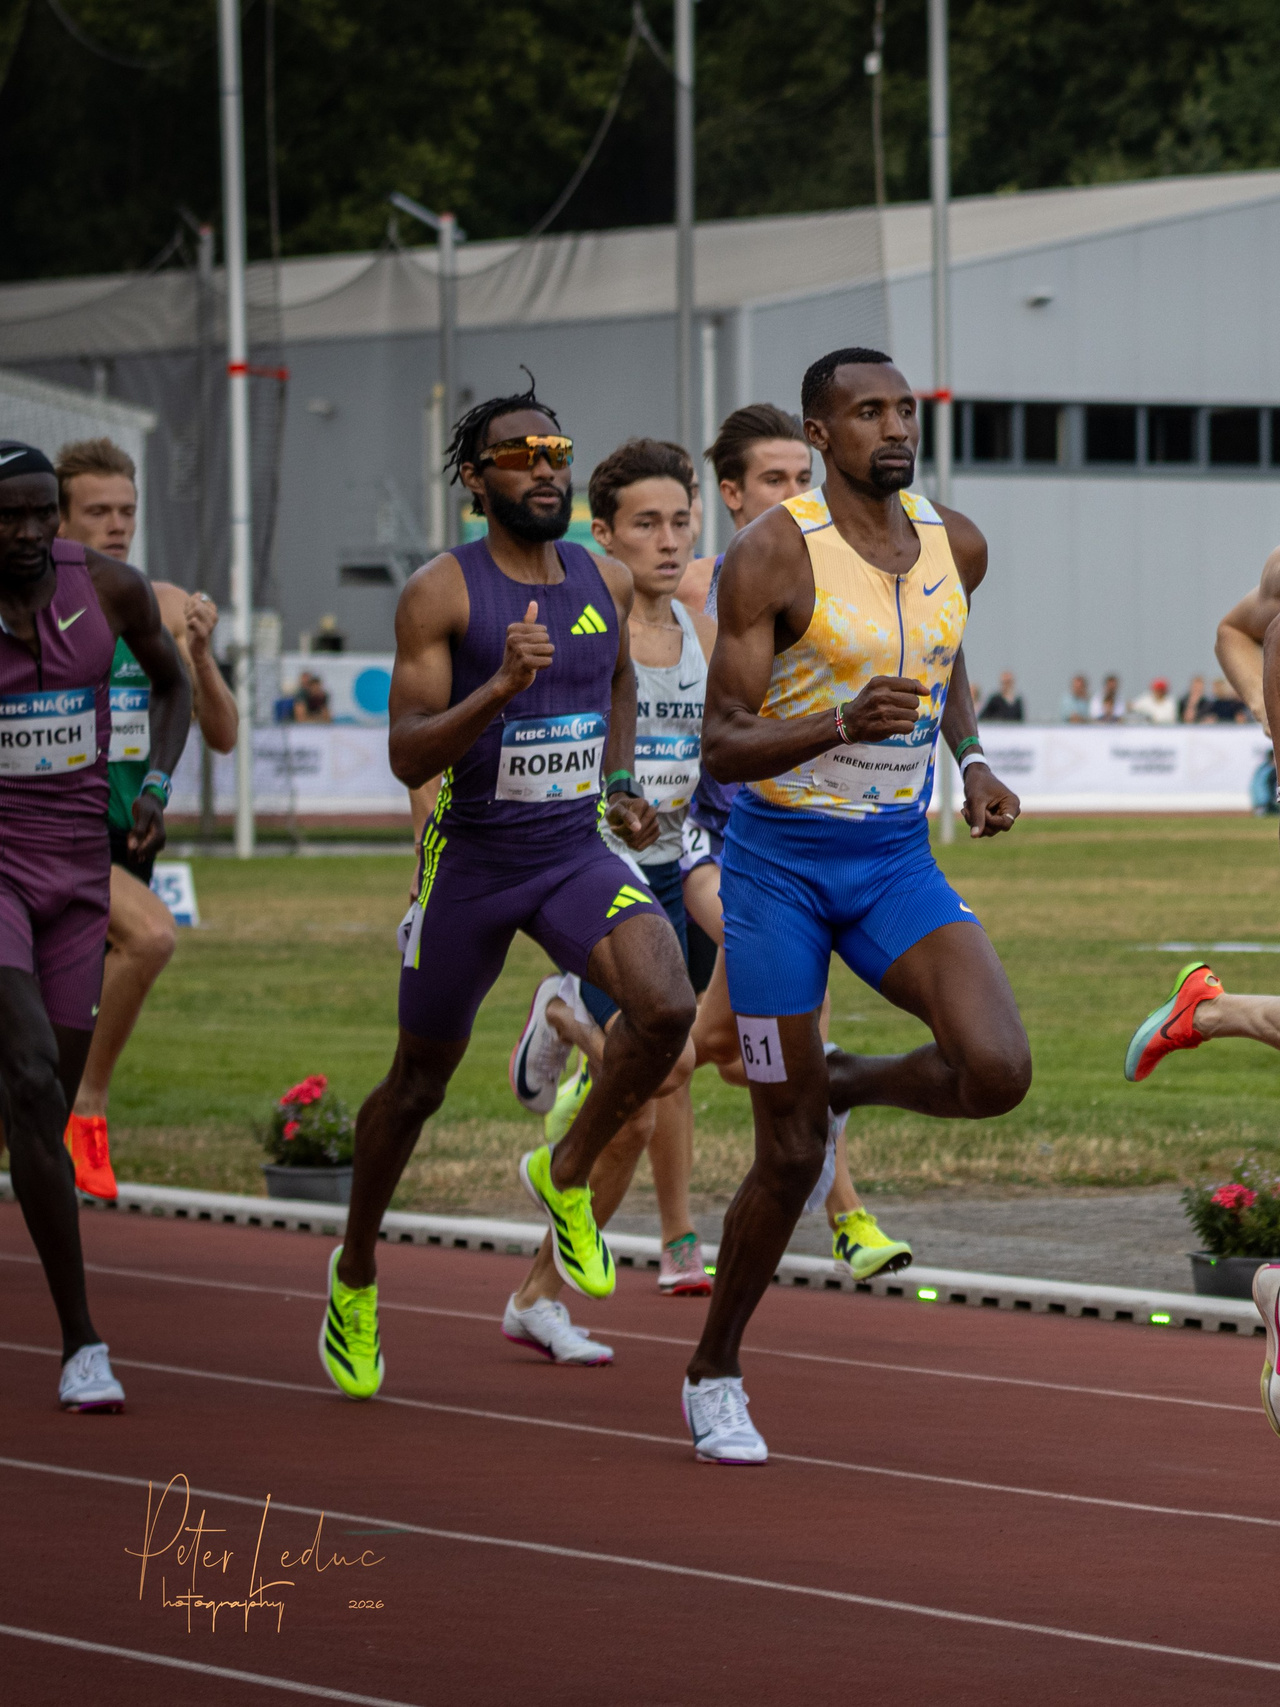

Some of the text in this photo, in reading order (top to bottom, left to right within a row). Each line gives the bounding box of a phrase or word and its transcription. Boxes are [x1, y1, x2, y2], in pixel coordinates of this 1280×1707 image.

[0, 725, 82, 749] ROTICH
[509, 747, 596, 776] ROBAN
[833, 753, 874, 771] KEBENEI
[655, 774, 690, 786] ALLON
[742, 1033, 772, 1066] 6.1
